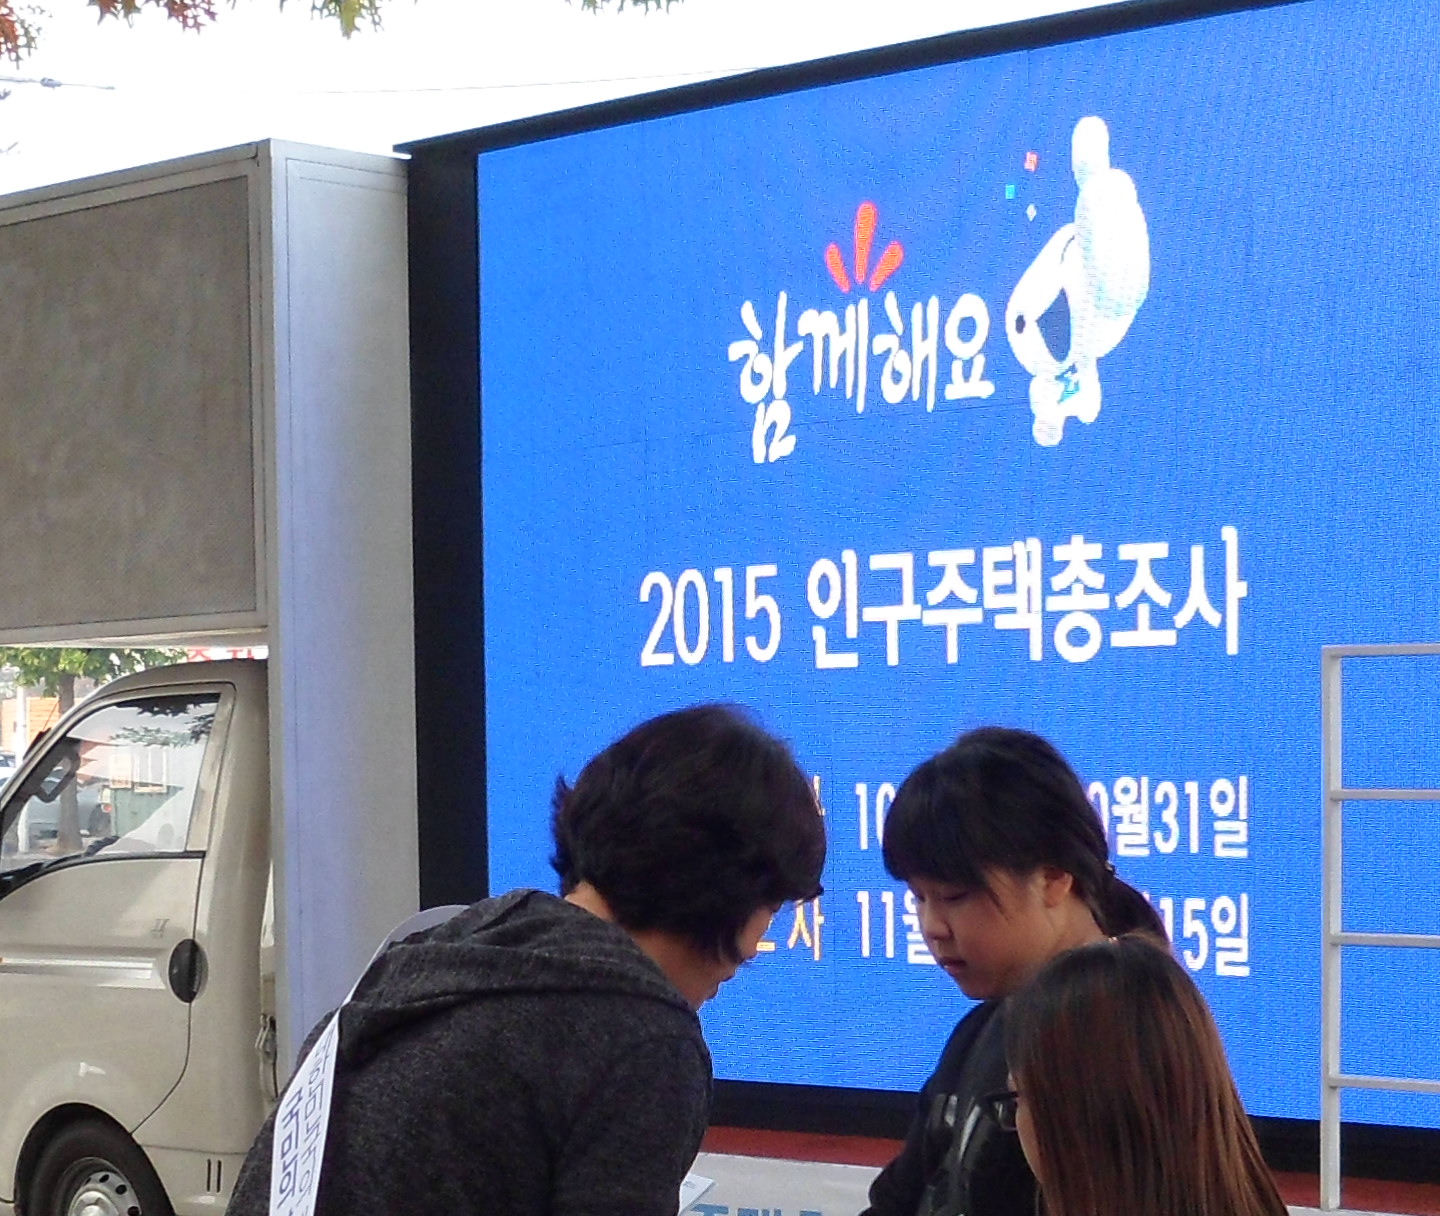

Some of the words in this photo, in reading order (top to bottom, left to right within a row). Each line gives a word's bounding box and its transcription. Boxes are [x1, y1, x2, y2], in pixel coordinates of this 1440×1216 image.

[728, 291, 995, 463] 함께해요
[639, 563, 782, 667] 2015
[806, 525, 1248, 669] 인구주택총조사
[276, 1087, 303, 1209] 국민의
